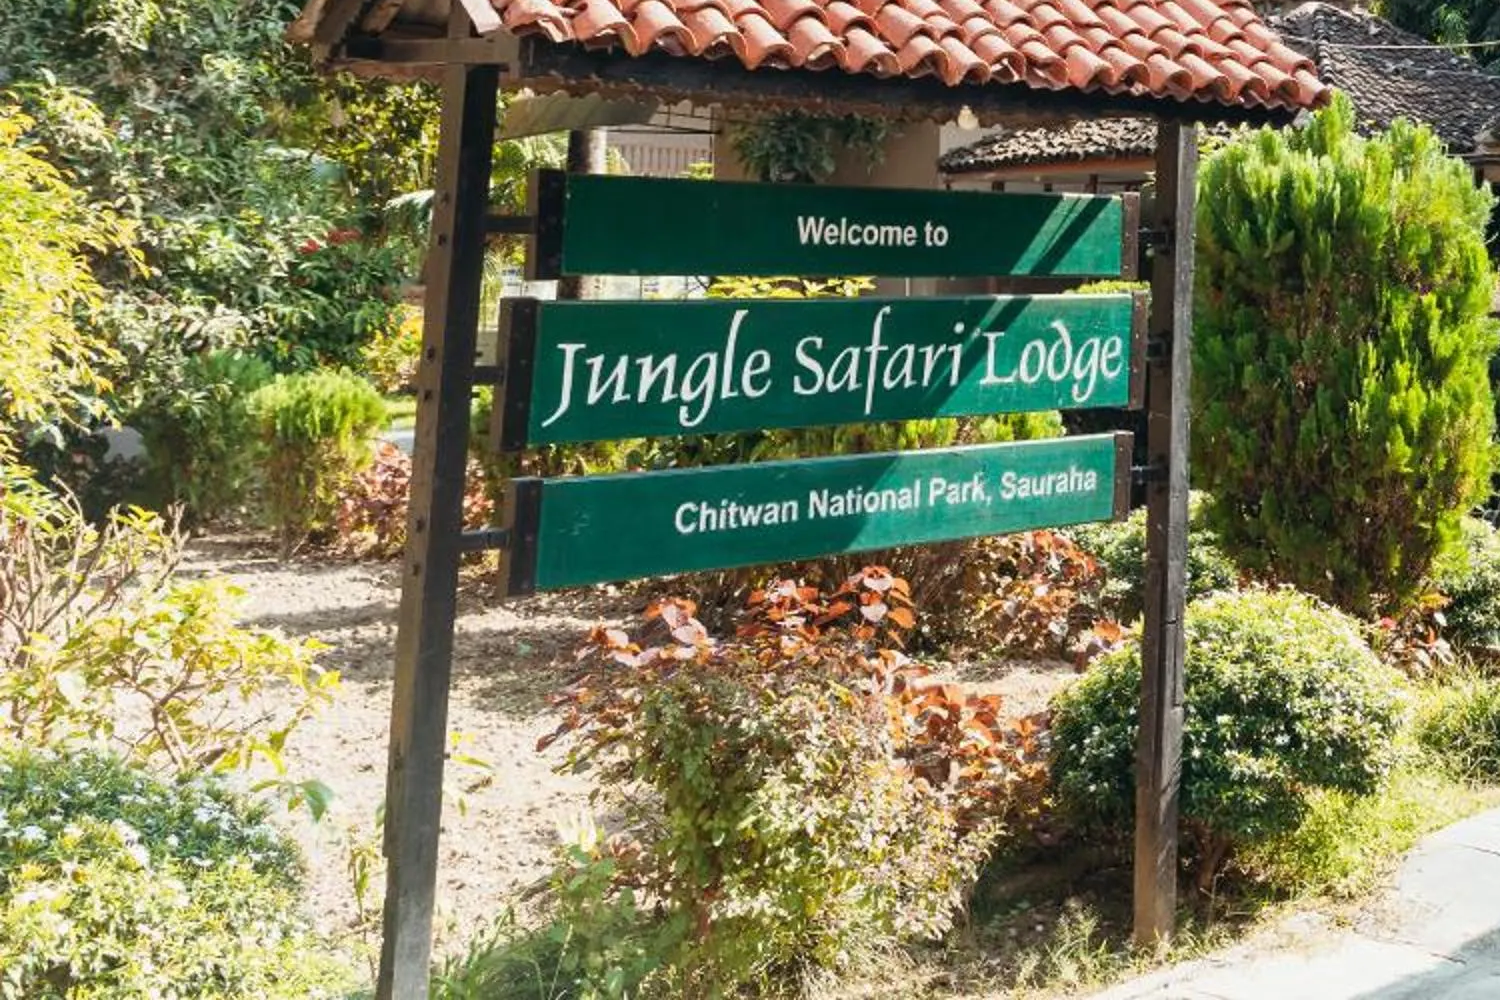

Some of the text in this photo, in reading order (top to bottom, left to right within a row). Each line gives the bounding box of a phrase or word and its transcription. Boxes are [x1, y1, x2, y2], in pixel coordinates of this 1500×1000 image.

[796, 215, 949, 247] Welcome to
[541, 305, 1123, 428] Jungle Safari Lodge
[674, 465, 1099, 535] Chitwan National Park, Sauraha
